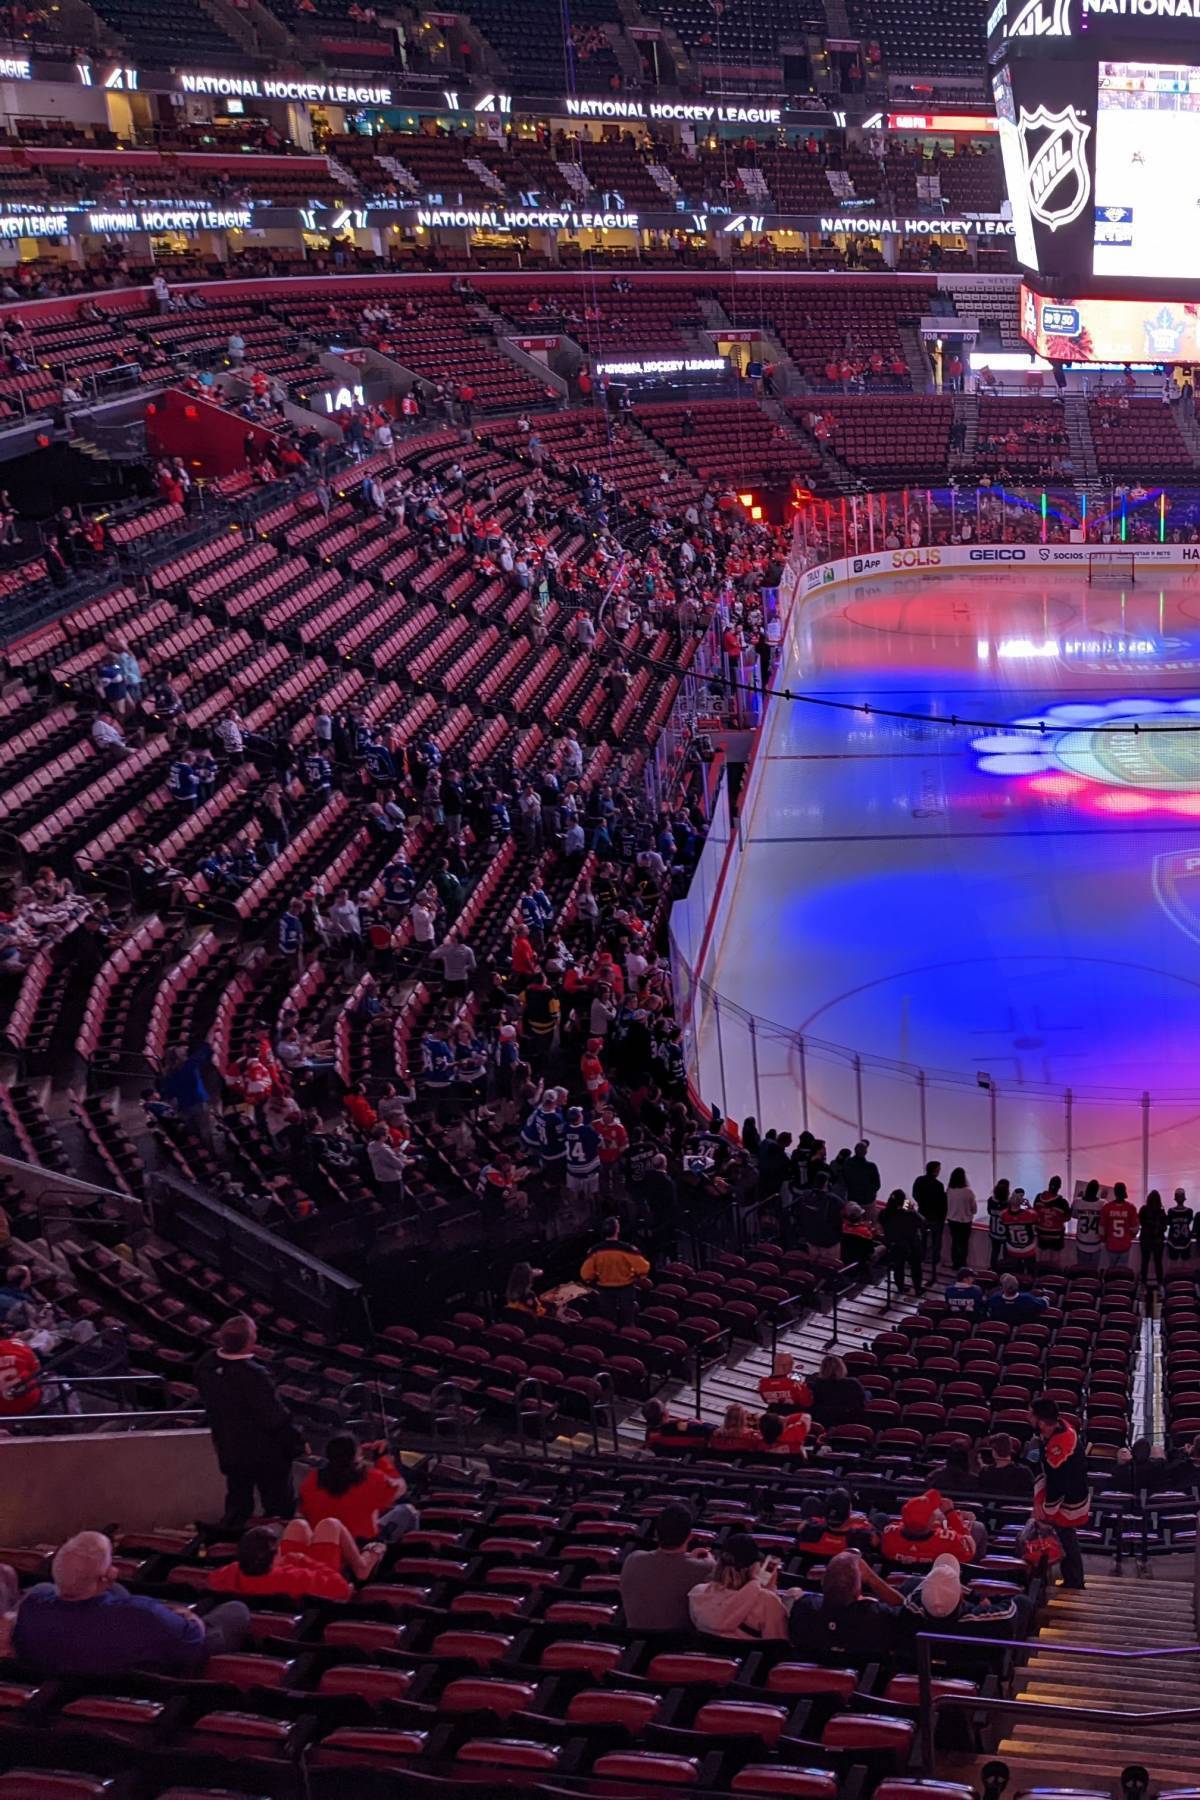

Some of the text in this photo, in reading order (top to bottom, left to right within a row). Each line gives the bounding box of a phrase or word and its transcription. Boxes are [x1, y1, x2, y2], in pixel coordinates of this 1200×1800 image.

[0, 60, 31, 80] AGUE
[182, 75, 392, 105] NATIONAL HOCKEY LEAGUE
[566, 100, 780, 124] NATIONAL HOCKEY LEAGUE
[26, 214, 68, 235] LEAGUE
[90, 211, 252, 232] NATIONAL HOCKEY LEAGUE
[418, 211, 639, 230] NATIONAL HOCKEY LEAGUE
[821, 218, 1016, 236] NATIONAL HOCKEY LEAG
[892, 548, 941, 569] SOLIS
[970, 549, 1025, 560] GEICO
[565, 1141, 586, 1163] 14
[1079, 1216, 1100, 1234] 34
[1112, 1219, 1126, 1239] 5
